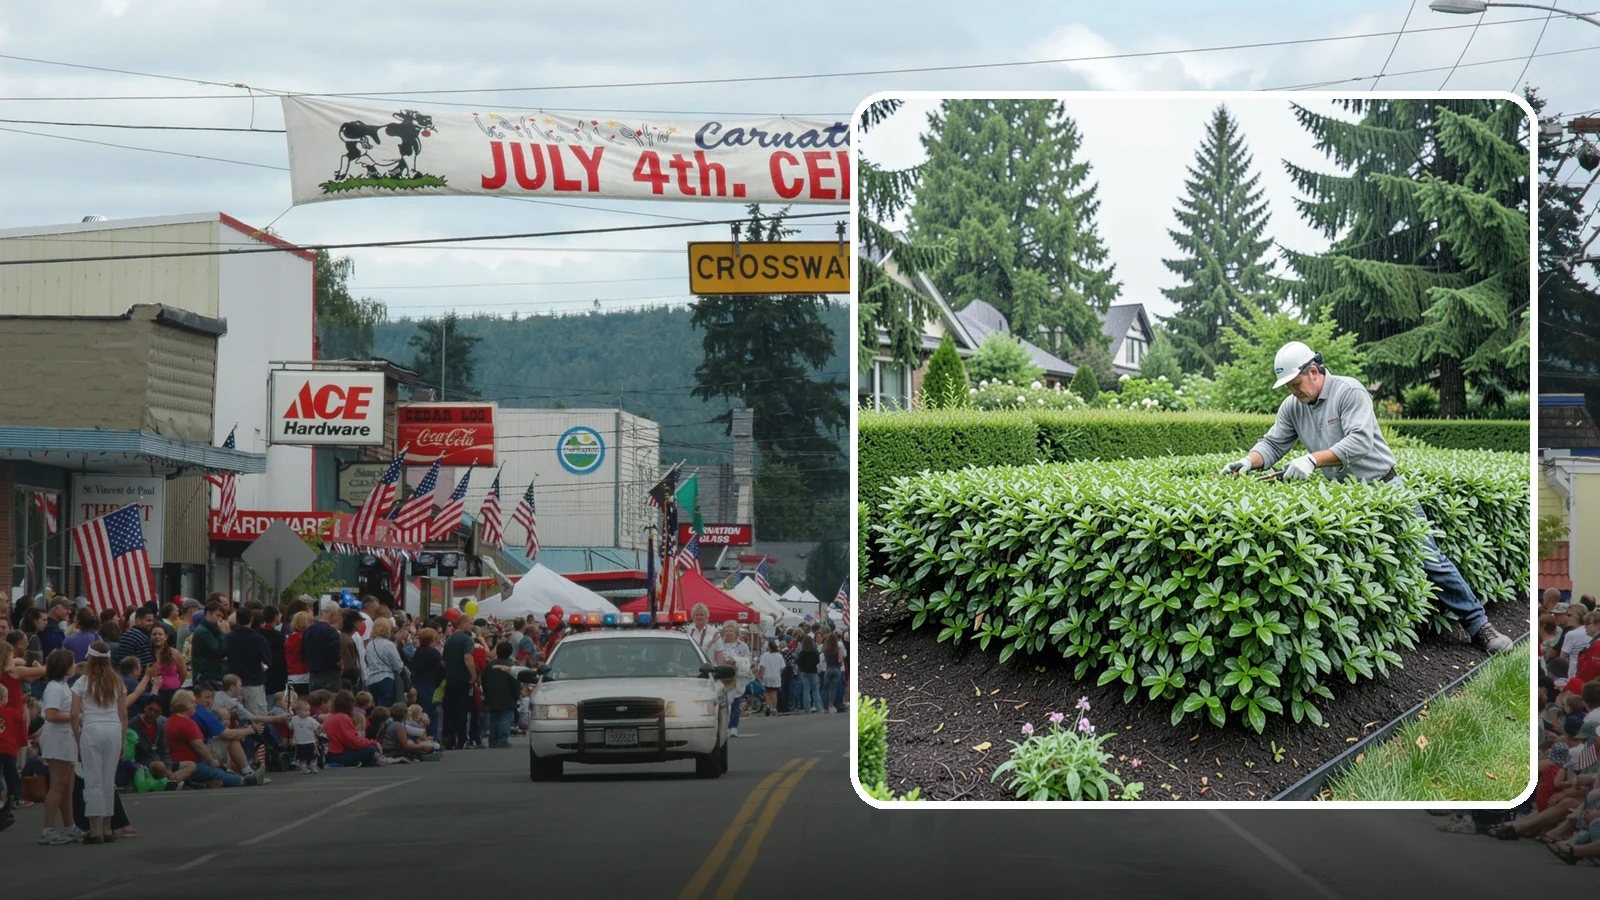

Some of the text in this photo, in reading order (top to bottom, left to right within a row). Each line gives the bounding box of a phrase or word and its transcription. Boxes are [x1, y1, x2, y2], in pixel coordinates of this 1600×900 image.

[481, 141, 605, 192] JULY
[632, 150, 746, 198] 4th.
[697, 254, 850, 280] CROSSWA
[283, 380, 373, 420] ACE
[405, 408, 485, 422] CEDAR LOG
[283, 421, 371, 437] Hardware
[416, 428, 477, 447] Coca-Cola
[353, 467, 386, 481] Simpl
[95, 485, 124, 495] Vincent
[126, 486, 135, 495] de
[137, 486, 155, 495] Paul
[688, 526, 741, 535] CRNATION
[699, 535, 730, 543] GLASS
